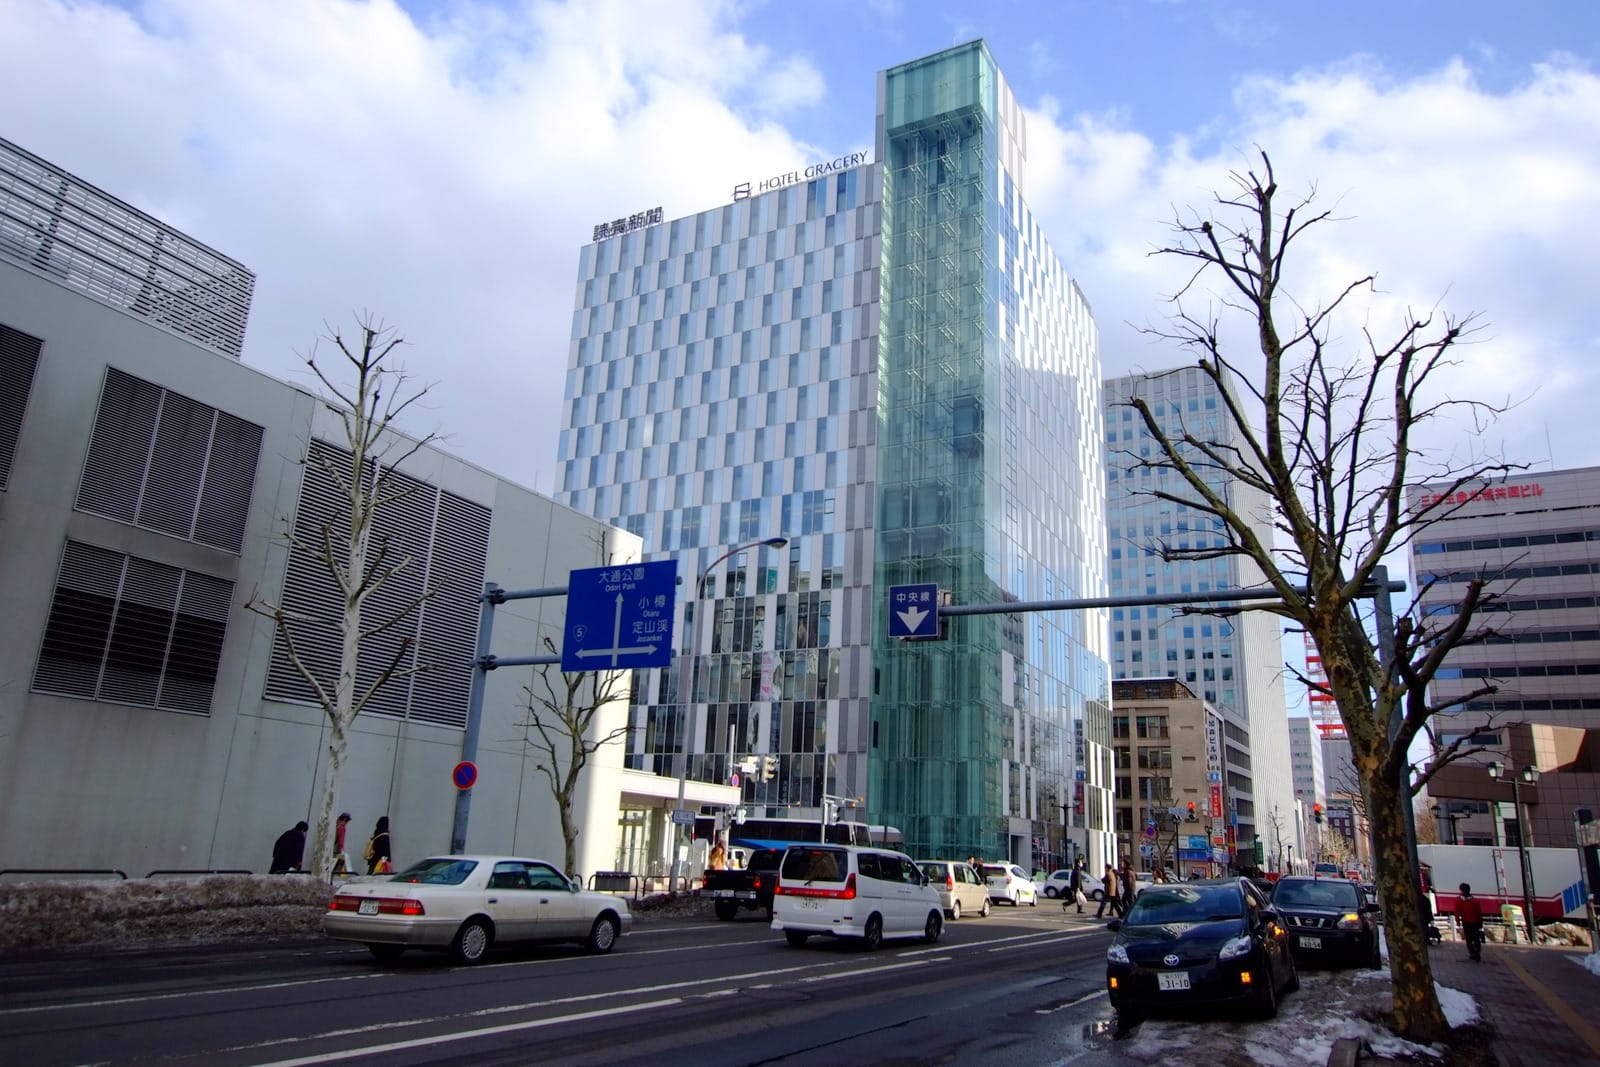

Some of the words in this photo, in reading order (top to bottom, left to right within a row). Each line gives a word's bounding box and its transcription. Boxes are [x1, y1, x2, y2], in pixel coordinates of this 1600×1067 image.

[759, 171, 801, 192] HOTEL
[804, 151, 868, 178] GRACERY
[598, 567, 645, 584] 大通公園
[605, 584, 621, 592] Odori
[622, 583, 636, 591] Park
[896, 591, 930, 603] 中央線
[1165, 979, 1190, 989] 31-10
